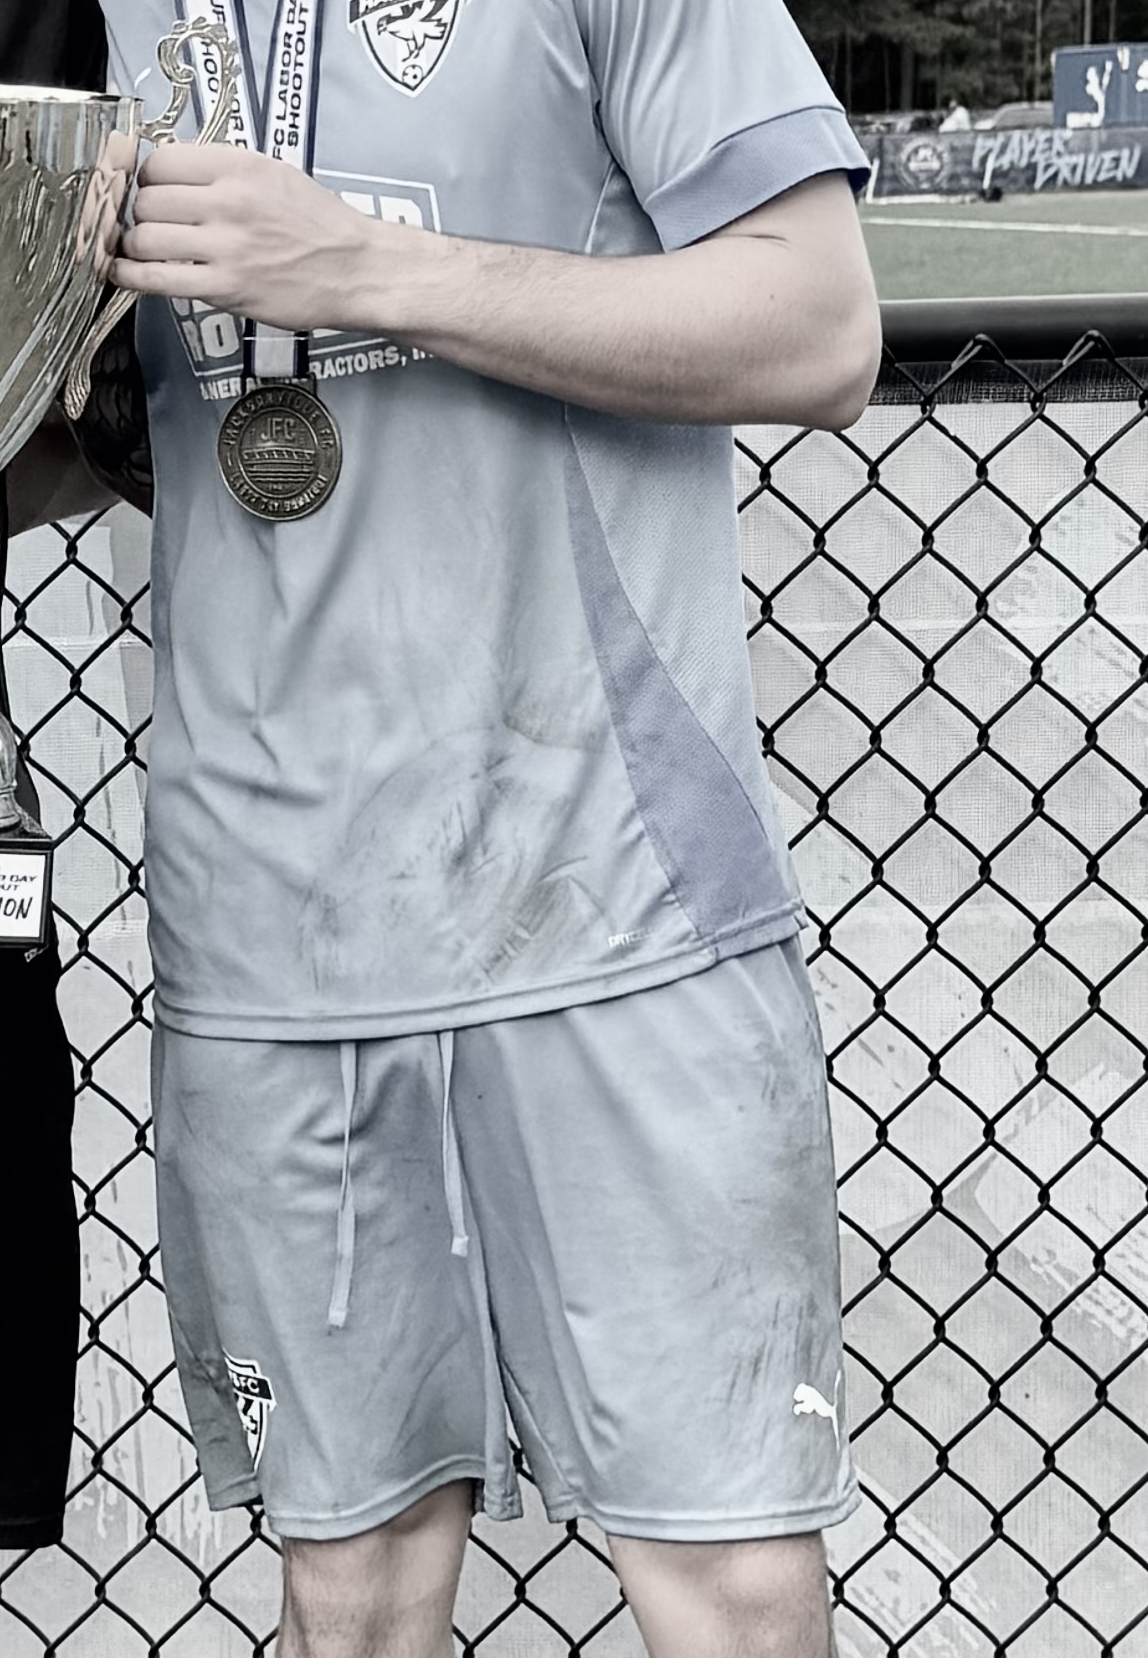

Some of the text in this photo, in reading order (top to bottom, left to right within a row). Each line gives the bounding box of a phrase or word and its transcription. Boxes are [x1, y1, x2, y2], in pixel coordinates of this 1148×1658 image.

[275, 31, 293, 121] LABOR
[287, 0, 309, 148] SHOOTOUT
[272, 128, 286, 161] FC
[972, 127, 1073, 172] PLAYER
[1033, 145, 1142, 190] DRIVEN
[307, 345, 408, 381] RACTORS,
[260, 416, 297, 441] JFC
[9, 874, 38, 883] DAY
